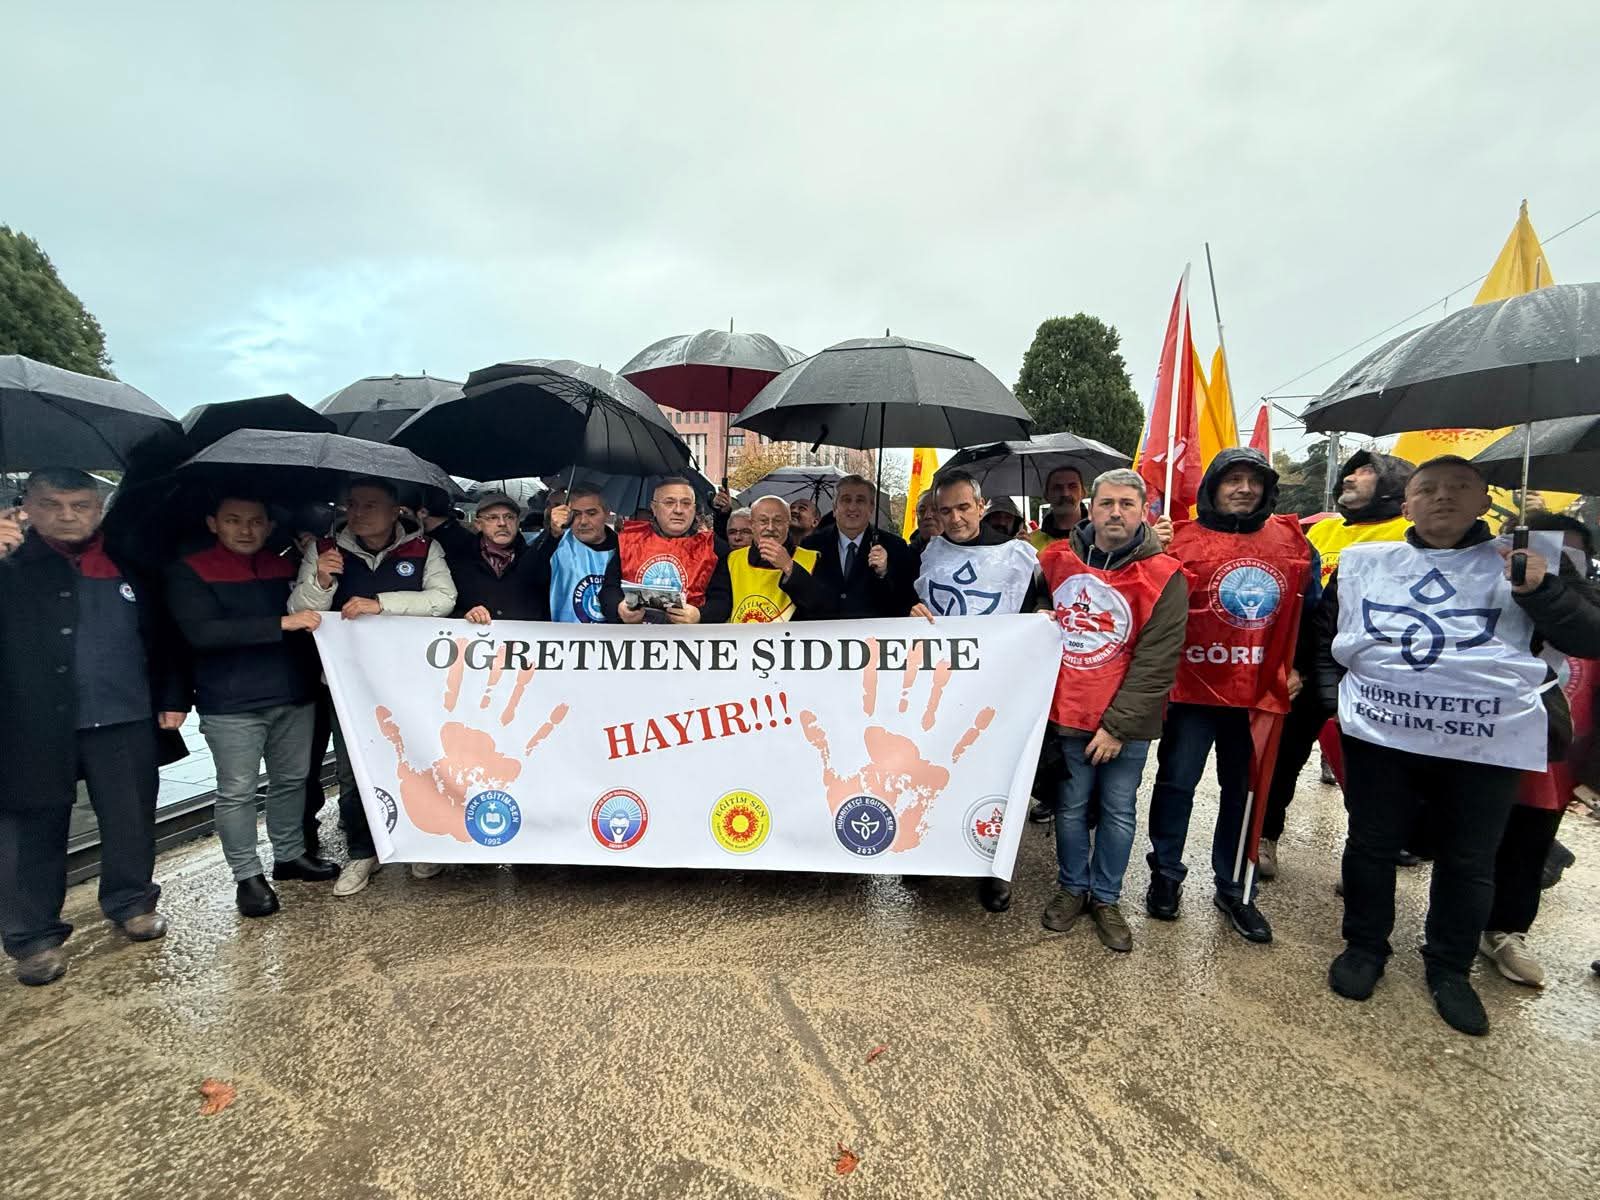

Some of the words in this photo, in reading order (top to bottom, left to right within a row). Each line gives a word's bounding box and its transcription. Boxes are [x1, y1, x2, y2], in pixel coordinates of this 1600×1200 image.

[574, 579, 590, 603] TÜRK
[425, 630, 738, 671] ÖĞRETMENE
[751, 631, 980, 679] ŞİDDETE
[1068, 640, 1084, 649] 2005
[1360, 684, 1501, 718] HÜRRİYETÇİ
[603, 691, 792, 760] HAYIR!!!
[1355, 701, 1496, 738] EĞİTİM-SEN
[467, 798, 480, 821] TÜRK
[480, 791, 520, 823] EĞİTİM-SEN
[484, 837, 502, 845] 1992
[984, 822, 1002, 836] ae
[856, 847, 877, 855] 2021
